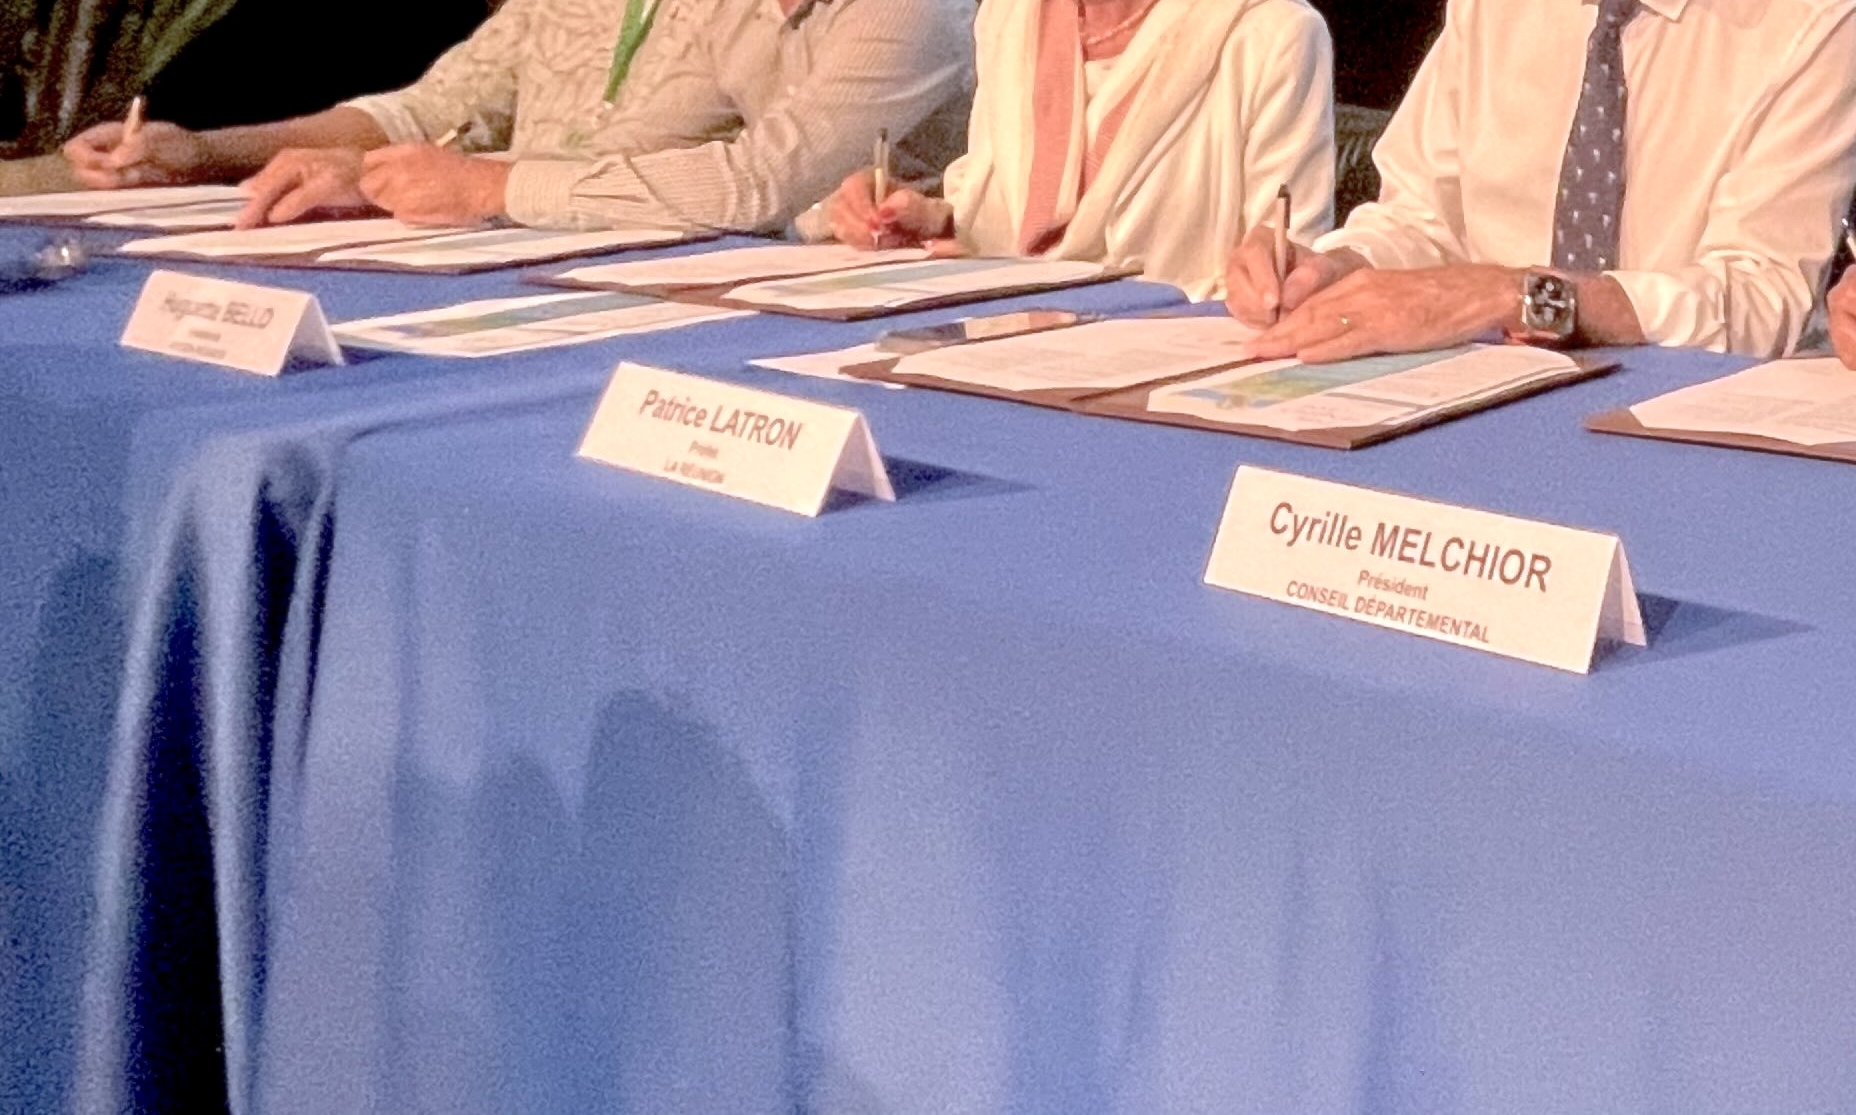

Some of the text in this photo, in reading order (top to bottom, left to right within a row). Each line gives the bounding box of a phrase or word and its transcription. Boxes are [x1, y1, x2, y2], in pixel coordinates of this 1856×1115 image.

[639, 389, 803, 450] Patrice LATRON
[1269, 502, 1552, 593] Cyrille MELCHIOR
[1286, 580, 1490, 644] CONSEIL DÉPARTEMENTAL
[1358, 569, 1429, 602] Président
